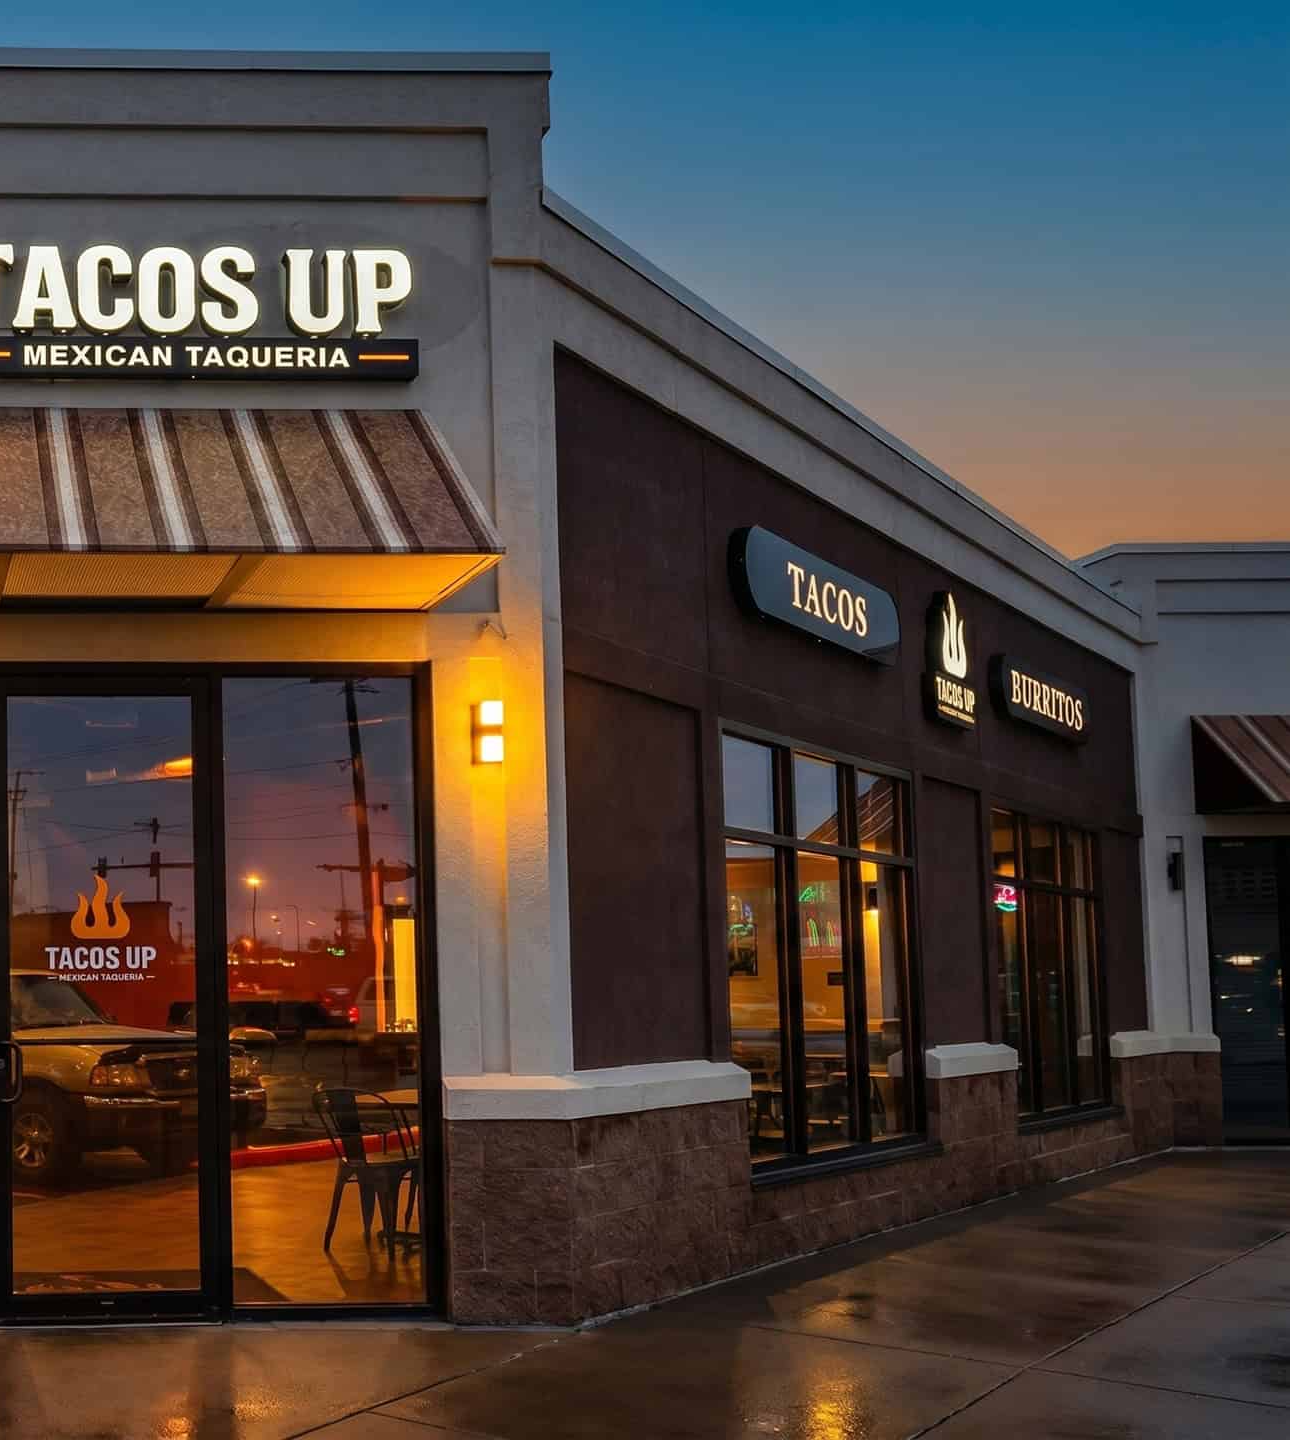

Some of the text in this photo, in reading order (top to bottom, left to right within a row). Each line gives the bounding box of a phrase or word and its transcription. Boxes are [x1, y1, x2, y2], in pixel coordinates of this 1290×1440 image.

[285, 248, 413, 334] UP
[22, 344, 351, 369] MEXICAN TAQUERIA
[787, 561, 868, 638] TACOS
[935, 675, 964, 711] TACOS
[963, 687, 975, 713] UP
[1010, 669, 1083, 731] BURRITOS
[44, 946, 157, 970] TACOS UP
[58, 973, 144, 982] MEXICAN TAQUERIA
